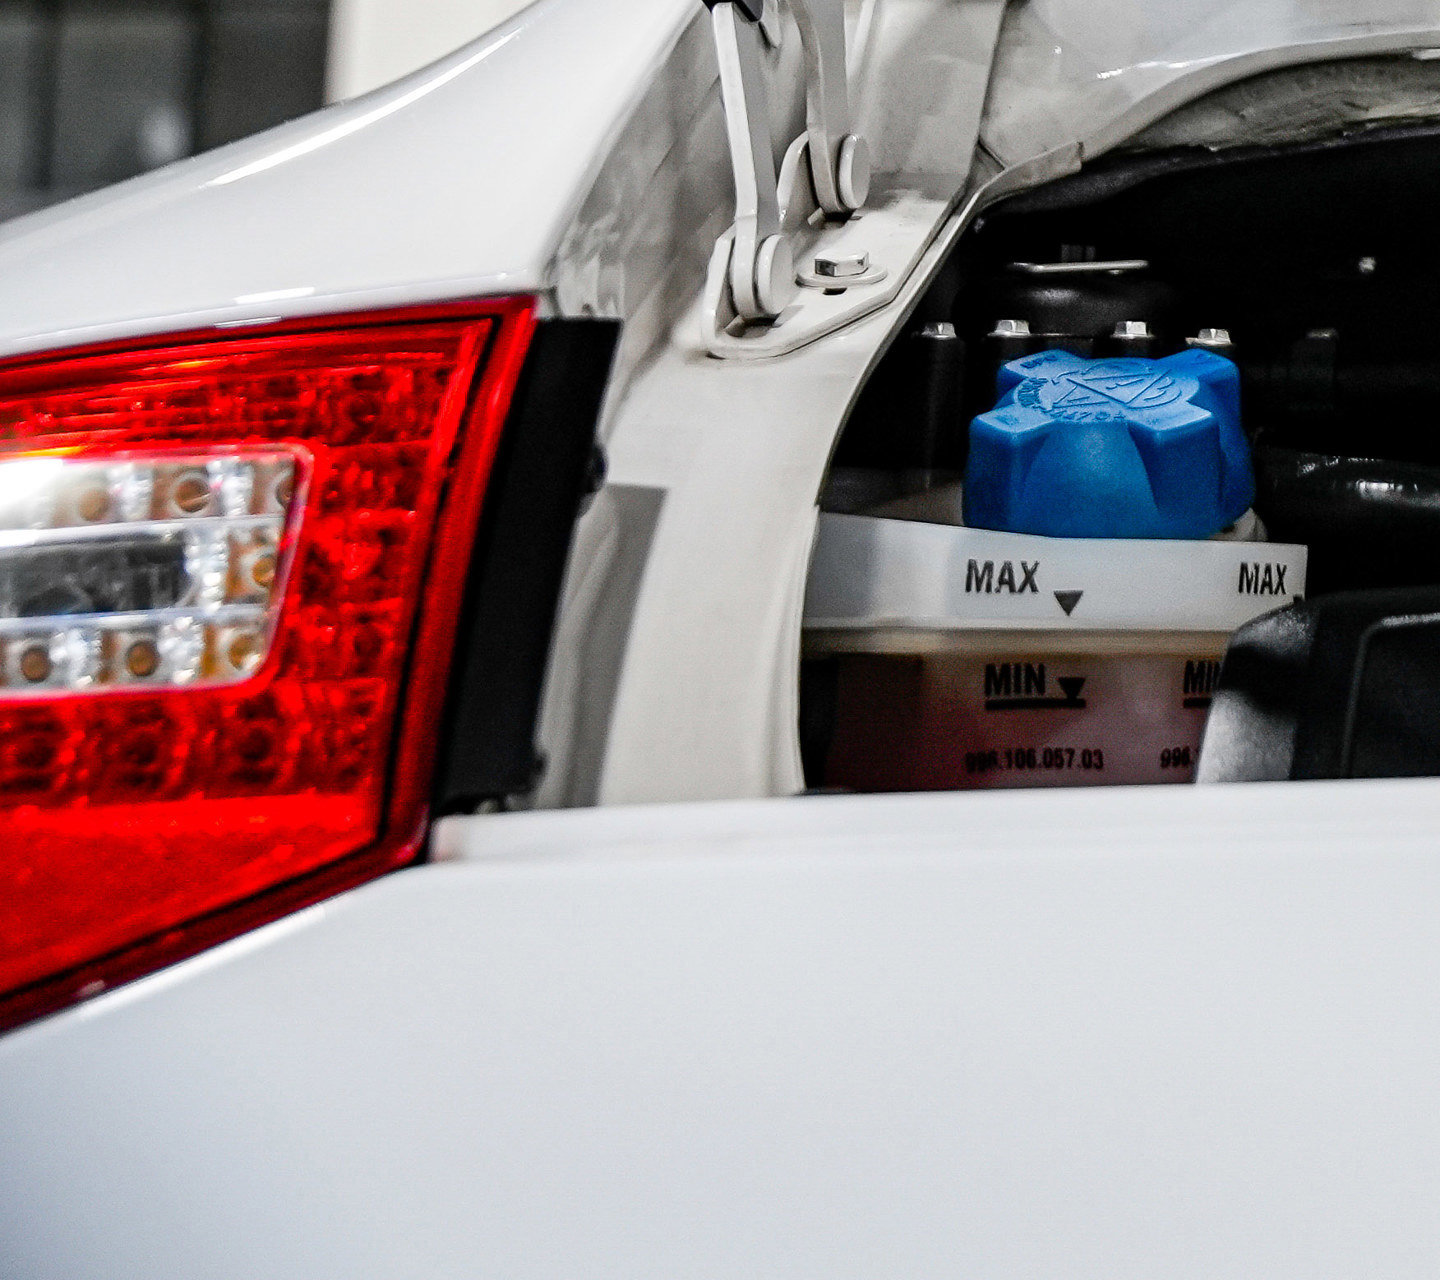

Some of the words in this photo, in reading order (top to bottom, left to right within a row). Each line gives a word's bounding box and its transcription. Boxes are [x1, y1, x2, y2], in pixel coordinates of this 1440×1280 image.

[965, 559, 1039, 594] MAX
[1238, 561, 1288, 596] MAX
[985, 663, 1046, 695] MIN
